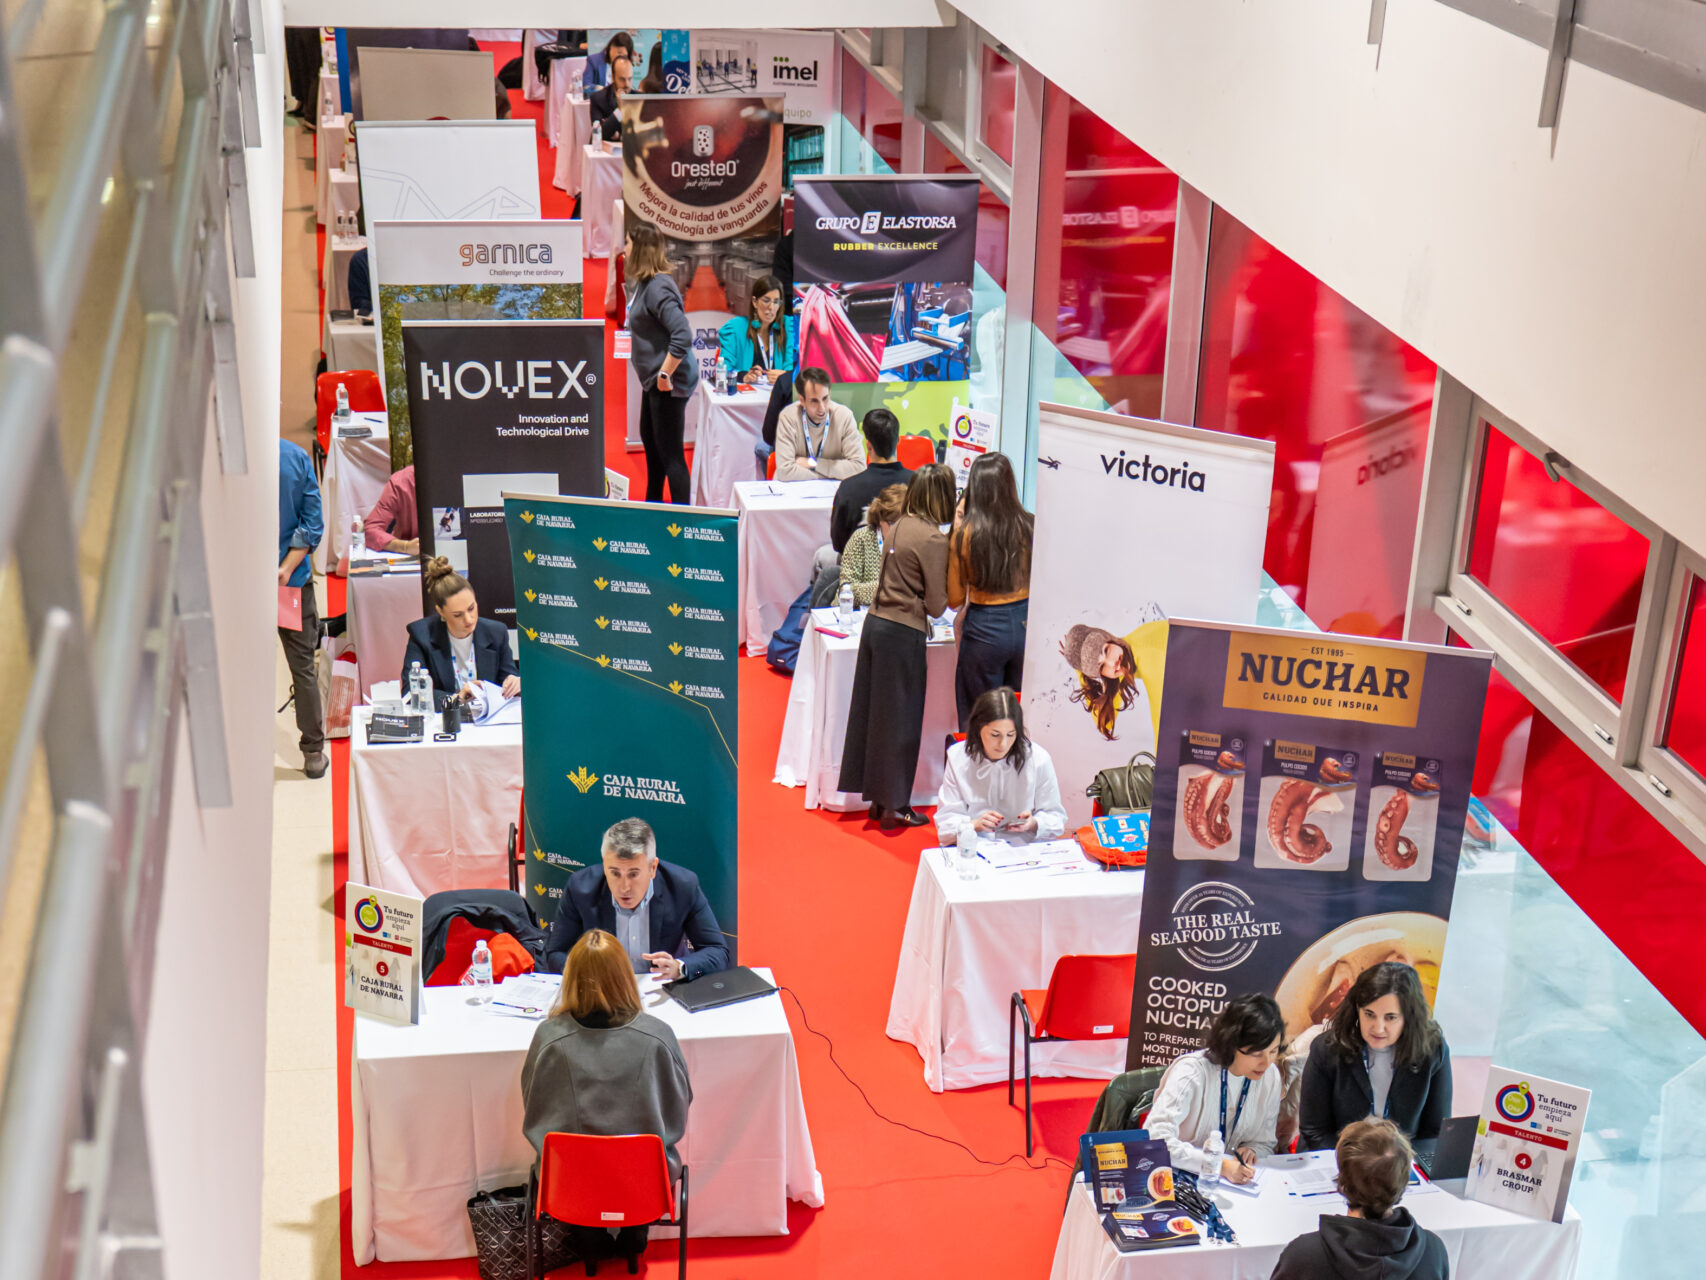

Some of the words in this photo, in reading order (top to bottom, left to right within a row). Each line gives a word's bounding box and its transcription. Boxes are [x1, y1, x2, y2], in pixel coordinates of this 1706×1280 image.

[773, 56, 818, 81] imel
[784, 108, 812, 119] quipo
[639, 181, 667, 211] Mejora
[669, 204, 678, 216] la
[680, 211, 715, 222] calidad
[717, 210, 729, 220] de
[730, 202, 746, 215] tus
[745, 180, 768, 204] vinos
[638, 201, 655, 218] con
[706, 224, 718, 235] de
[720, 198, 769, 232] vanguardia
[816, 216, 860, 230] GRUPO
[882, 215, 956, 229] ELASTORSA
[833, 243, 875, 251] RUBBER
[877, 242, 938, 250] EXCELLENCE
[459, 243, 553, 267] garnica
[489, 269, 522, 278] Challenge
[536, 269, 564, 278] ordinary
[518, 413, 569, 424] Innovation
[570, 413, 589, 424] and
[496, 426, 563, 438] Technological
[564, 426, 589, 436] Drive
[1100, 450, 1206, 493] victoria
[1311, 646, 1324, 655] EST
[1237, 652, 1411, 700] NUCHAR
[1263, 692, 1307, 704] CALIDAD
[1312, 697, 1332, 707] QUE
[1338, 700, 1379, 712] INSPIRA
[603, 774, 635, 787] CAJA
[636, 777, 680, 793] RURAL
[603, 785, 621, 797] DE
[625, 787, 686, 805] NAVARRA
[384, 905, 393, 914] Tu
[394, 907, 414, 919] futuro
[1173, 914, 1208, 930] THE
[1211, 910, 1255, 927] REAL
[1150, 928, 1226, 947] SEAFOOD
[1229, 921, 1282, 939] TASTE
[360, 976, 378, 986] CAJA
[380, 980, 404, 992] RURAL
[1149, 976, 1227, 998] COOKED
[360, 984, 370, 992] DE
[370, 987, 404, 1001] NAVARRA
[1145, 1009, 1218, 1030] NUCHA
[1144, 1031, 1157, 1041] TO
[1160, 1033, 1201, 1047] PREPARE
[1142, 1043, 1171, 1055] MOST
[1141, 1054, 1173, 1066] HEALT
[1537, 1093, 1549, 1104] Tu
[1550, 1096, 1578, 1111] futuro
[1538, 1103, 1572, 1118] empieza
[1514, 1129, 1543, 1142] TALENTO
[1519, 1157, 1527, 1166] 4
[1496, 1167, 1543, 1187] BRASMAR
[1502, 1180, 1534, 1194] GROUP
